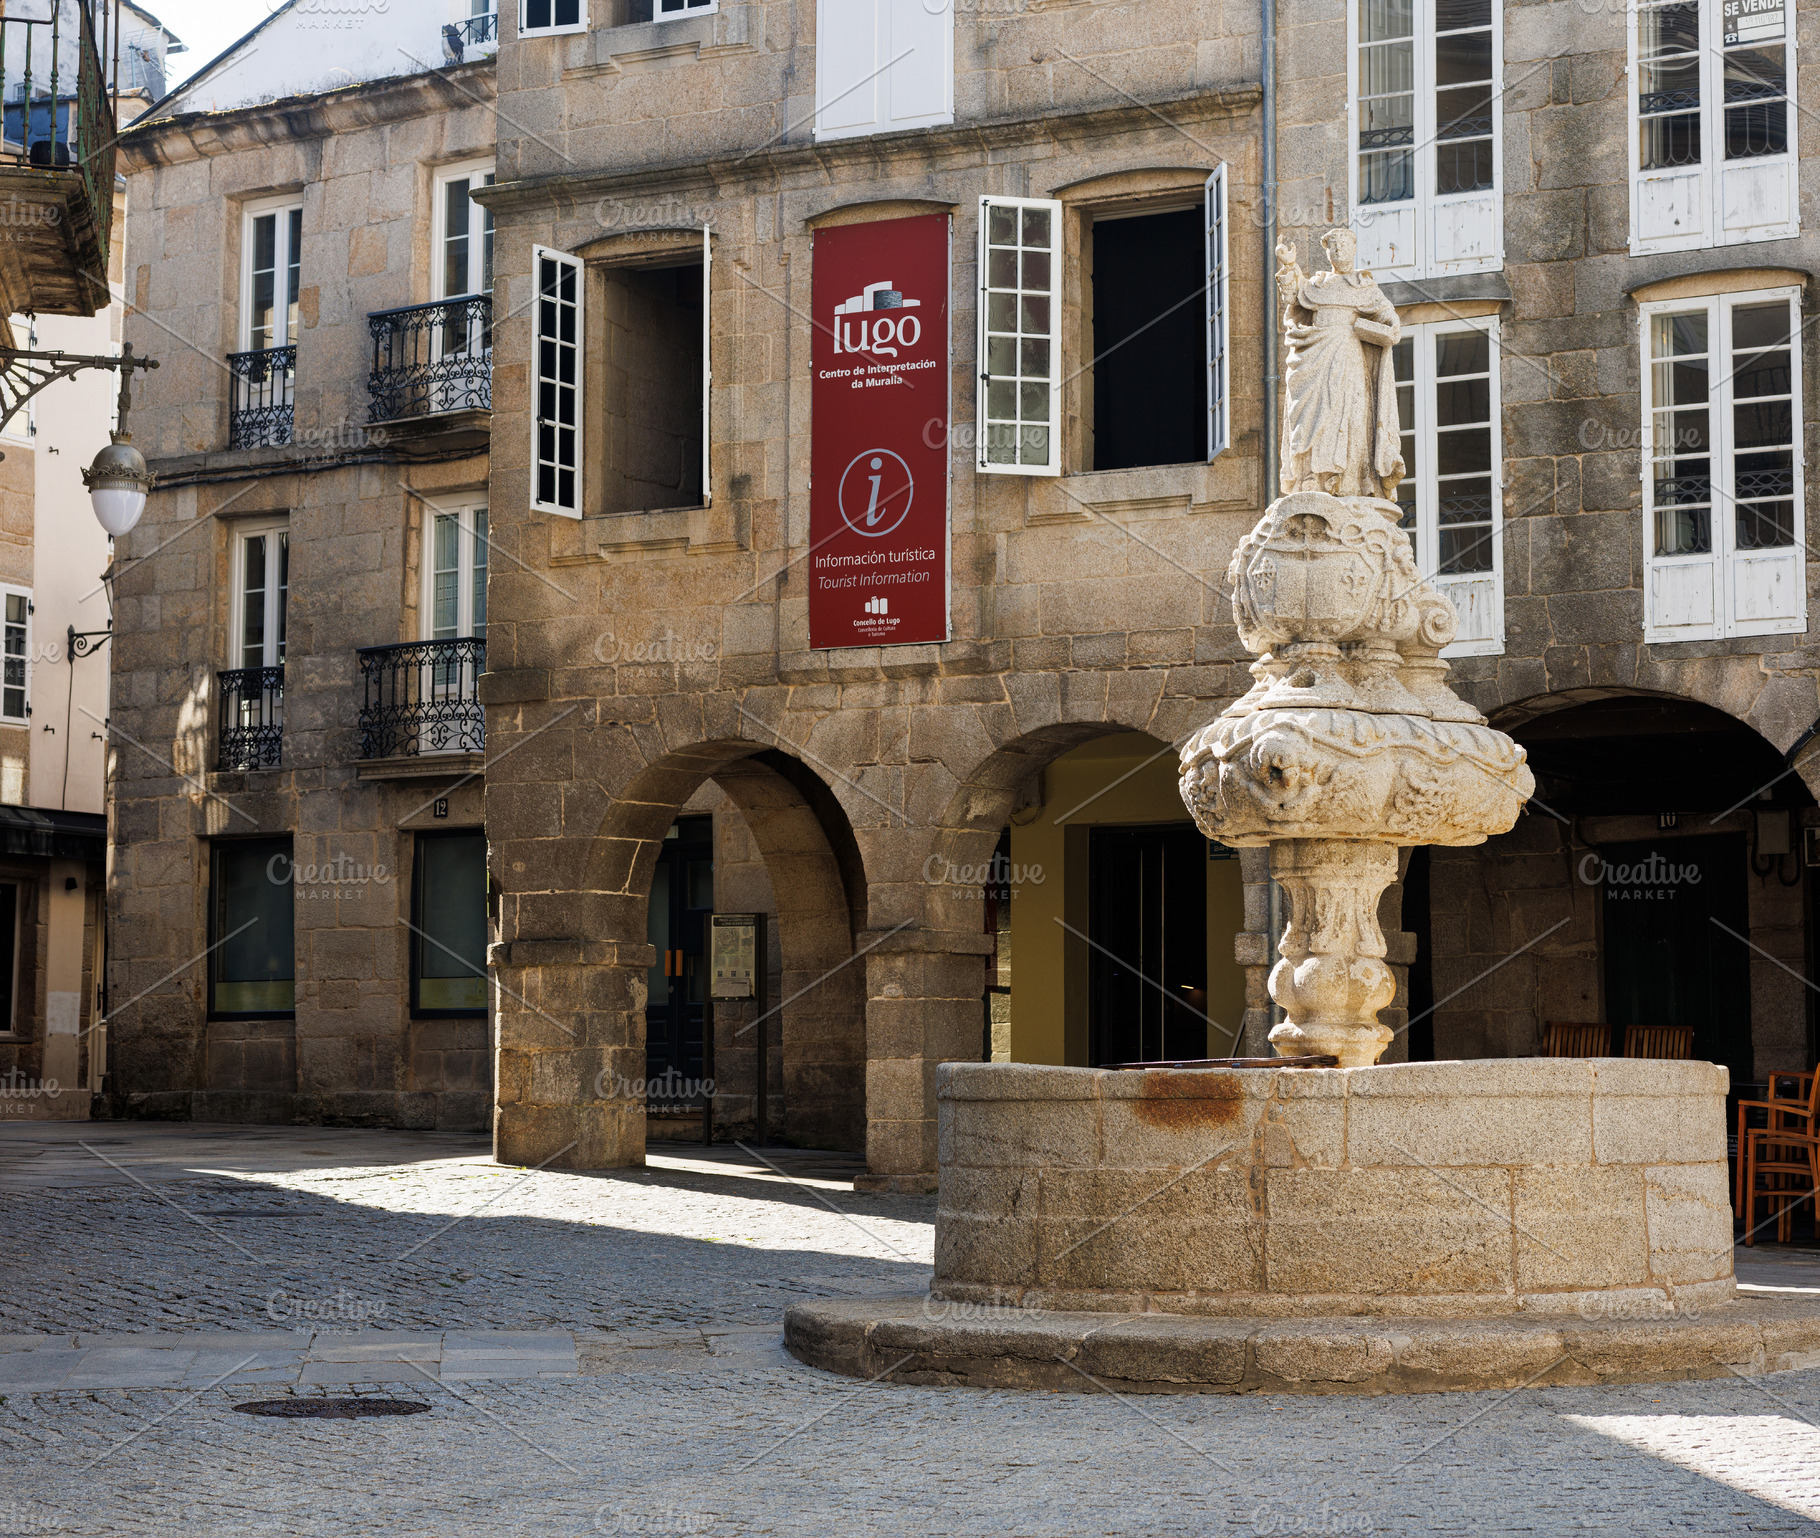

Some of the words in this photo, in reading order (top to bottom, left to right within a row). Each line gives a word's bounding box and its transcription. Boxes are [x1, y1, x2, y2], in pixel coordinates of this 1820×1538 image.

[1724, 1, 1740, 17] SE
[1742, 0, 1784, 13] VENDE
[833, 315, 921, 358] lugo
[819, 368, 851, 380] Centro
[853, 365, 865, 376] de
[867, 359, 937, 374] Interpretación
[851, 378, 863, 389] da
[865, 375, 903, 388] Muralla
[815, 550, 886, 568] Información
[888, 547, 936, 563] turística
[818, 574, 857, 590] Tourist
[859, 569, 930, 586] Information
[853, 618, 877, 626] Concello
[877, 617, 886, 625] de
[886, 617, 901, 626] Lugo
[436, 800, 447, 815] 12
[1660, 812, 1676, 828] 10
